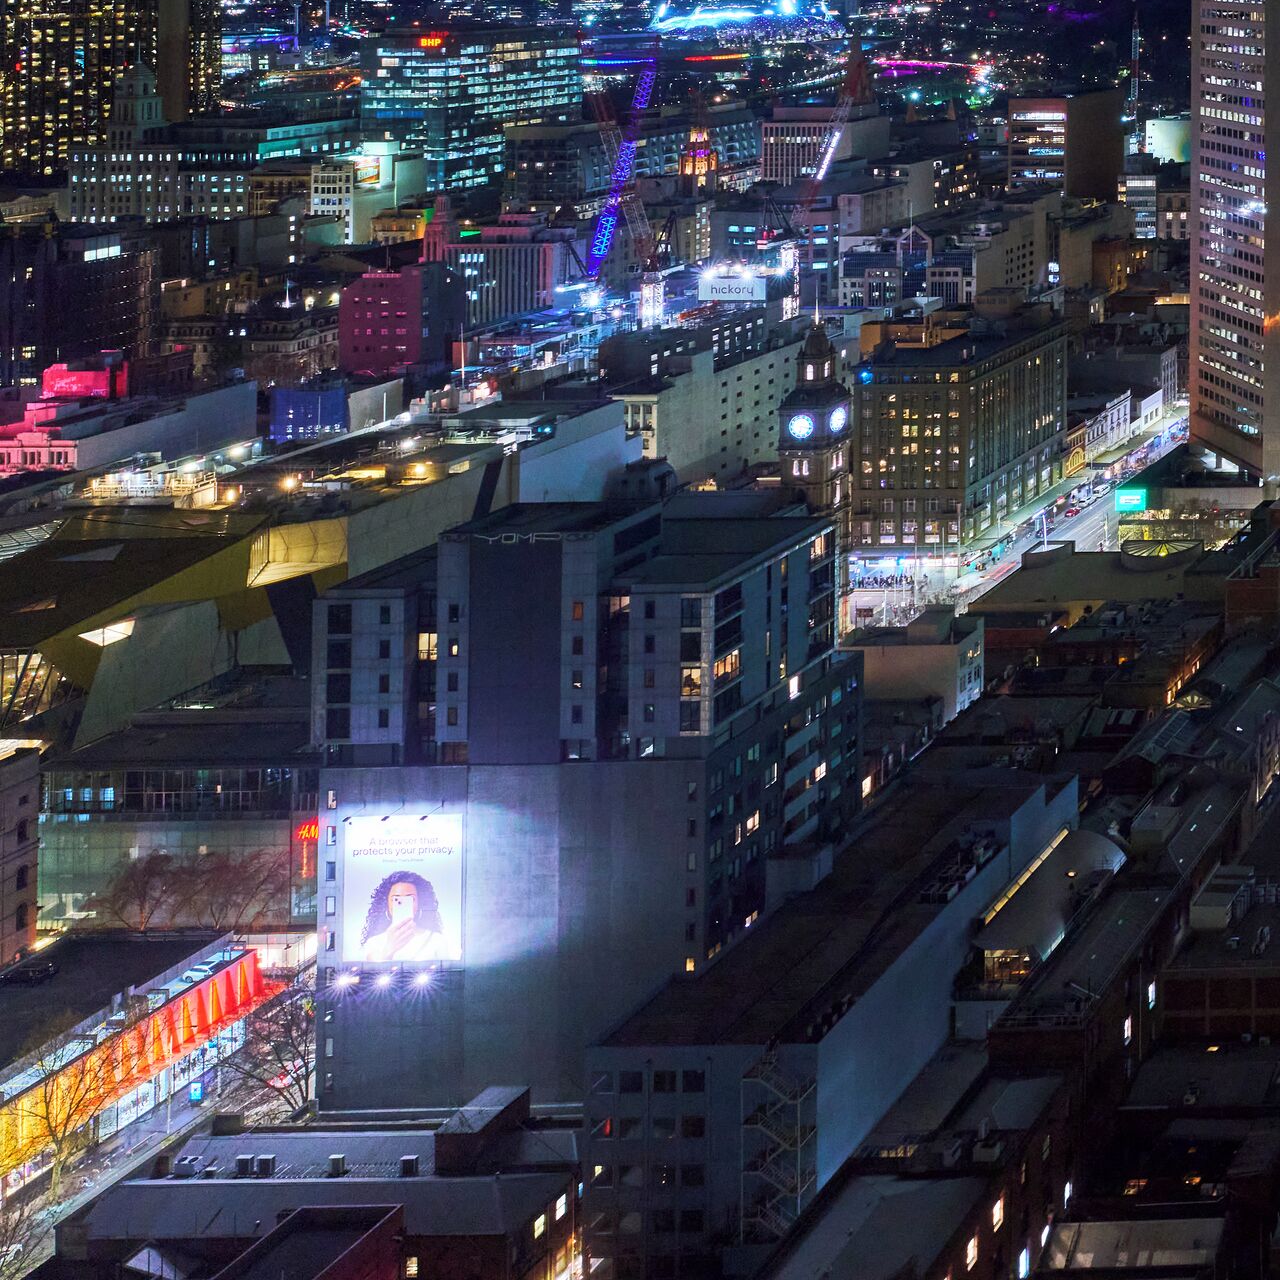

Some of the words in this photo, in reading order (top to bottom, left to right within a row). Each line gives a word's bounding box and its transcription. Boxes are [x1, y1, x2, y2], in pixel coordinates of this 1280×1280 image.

[420, 38, 442, 47] BHP
[710, 284, 754, 296] hickory
[379, 838, 417, 846] browser
[420, 837, 438, 845] that
[352, 848, 393, 857] protects
[395, 848, 415, 856] your
[418, 846, 455, 855] privacy.
